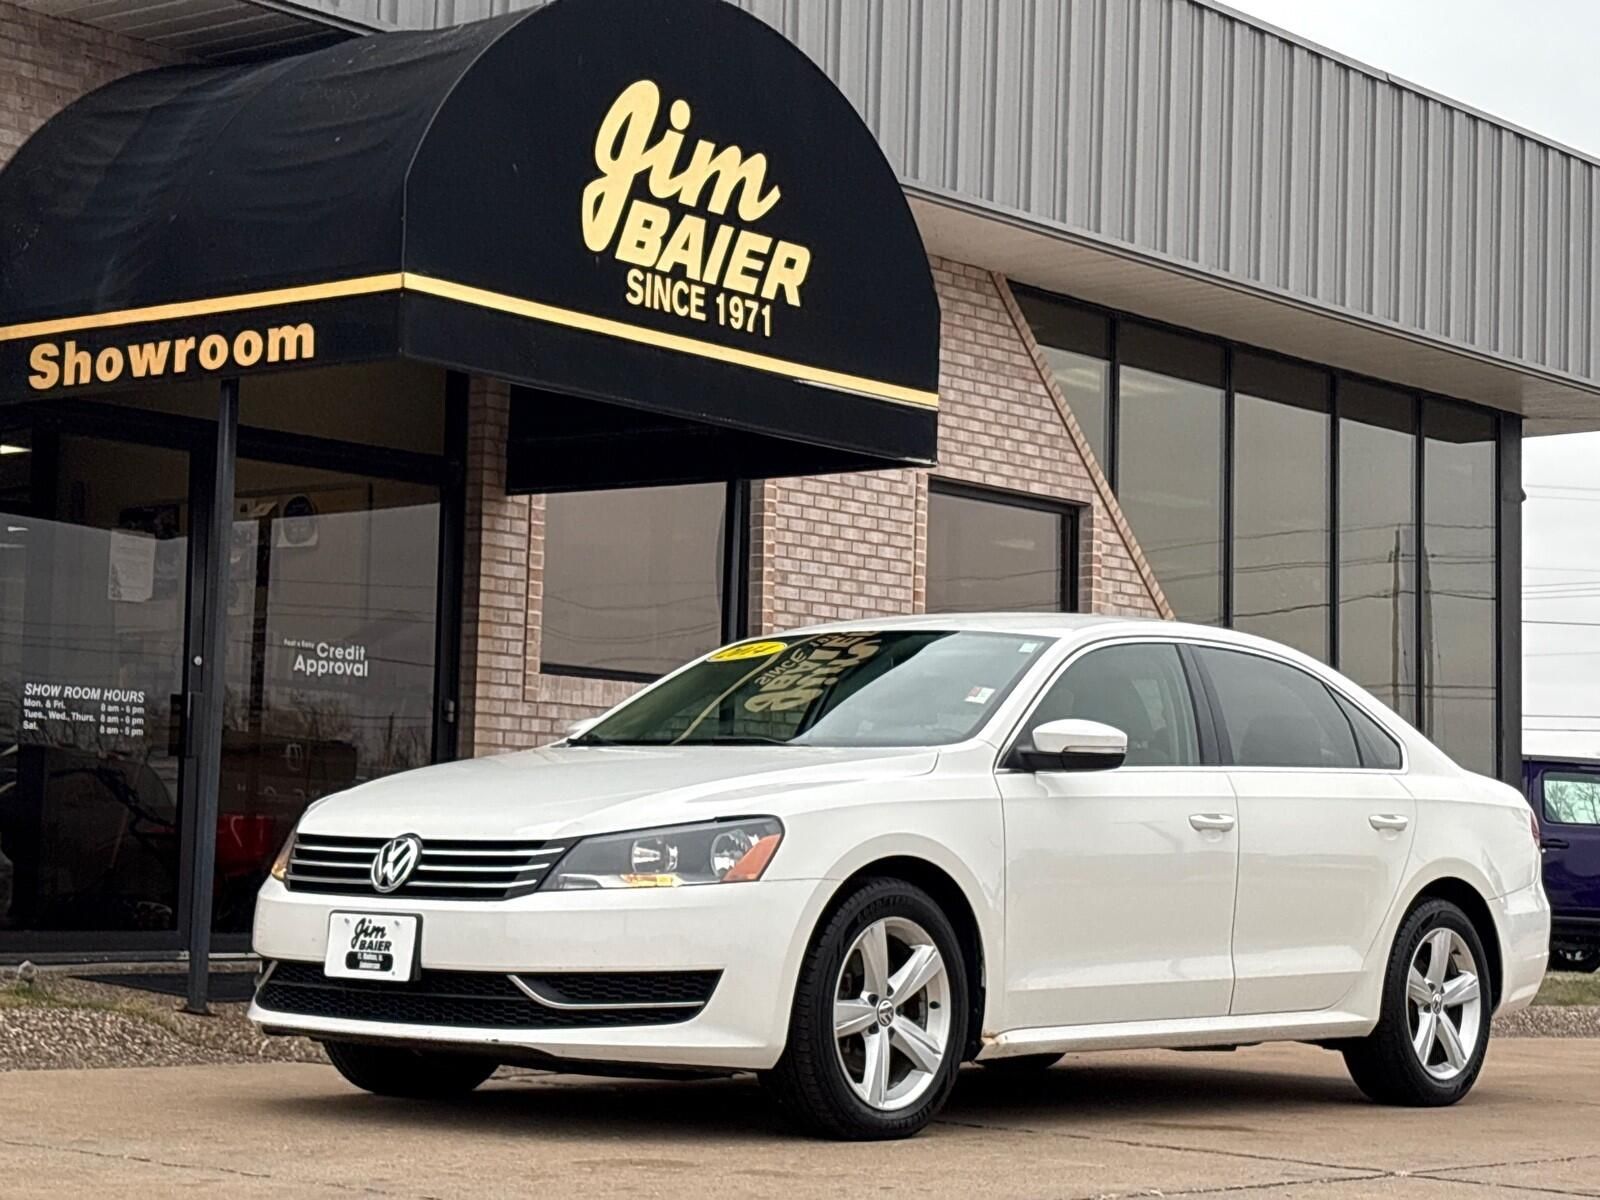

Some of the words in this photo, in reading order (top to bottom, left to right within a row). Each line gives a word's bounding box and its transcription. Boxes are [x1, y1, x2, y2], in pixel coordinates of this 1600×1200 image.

[582, 80, 781, 252] Jim
[615, 200, 811, 307] BAIER
[626, 269, 707, 321] SINCE
[716, 293, 771, 337] 1971
[28, 322, 315, 389] Showroom
[316, 642, 366, 661] Credit
[293, 654, 368, 677] Approval
[24, 683, 62, 697] SHOW
[63, 685, 101, 700] ROOM
[103, 689, 145, 703] HOURS
[23, 697, 43, 708] Mon.
[53, 699, 66, 709] Fri.
[107, 704, 120, 713] am
[132, 706, 145, 715] pm
[23, 720, 39, 730] Sat.
[106, 726, 119, 735] am
[130, 728, 144, 738] pm
[71, 711, 96, 722] Thurs.
[106, 715, 119, 724] am
[131, 717, 144, 726] pm
[351, 917, 387, 949] Jim
[358, 939, 393, 952] BAIER
